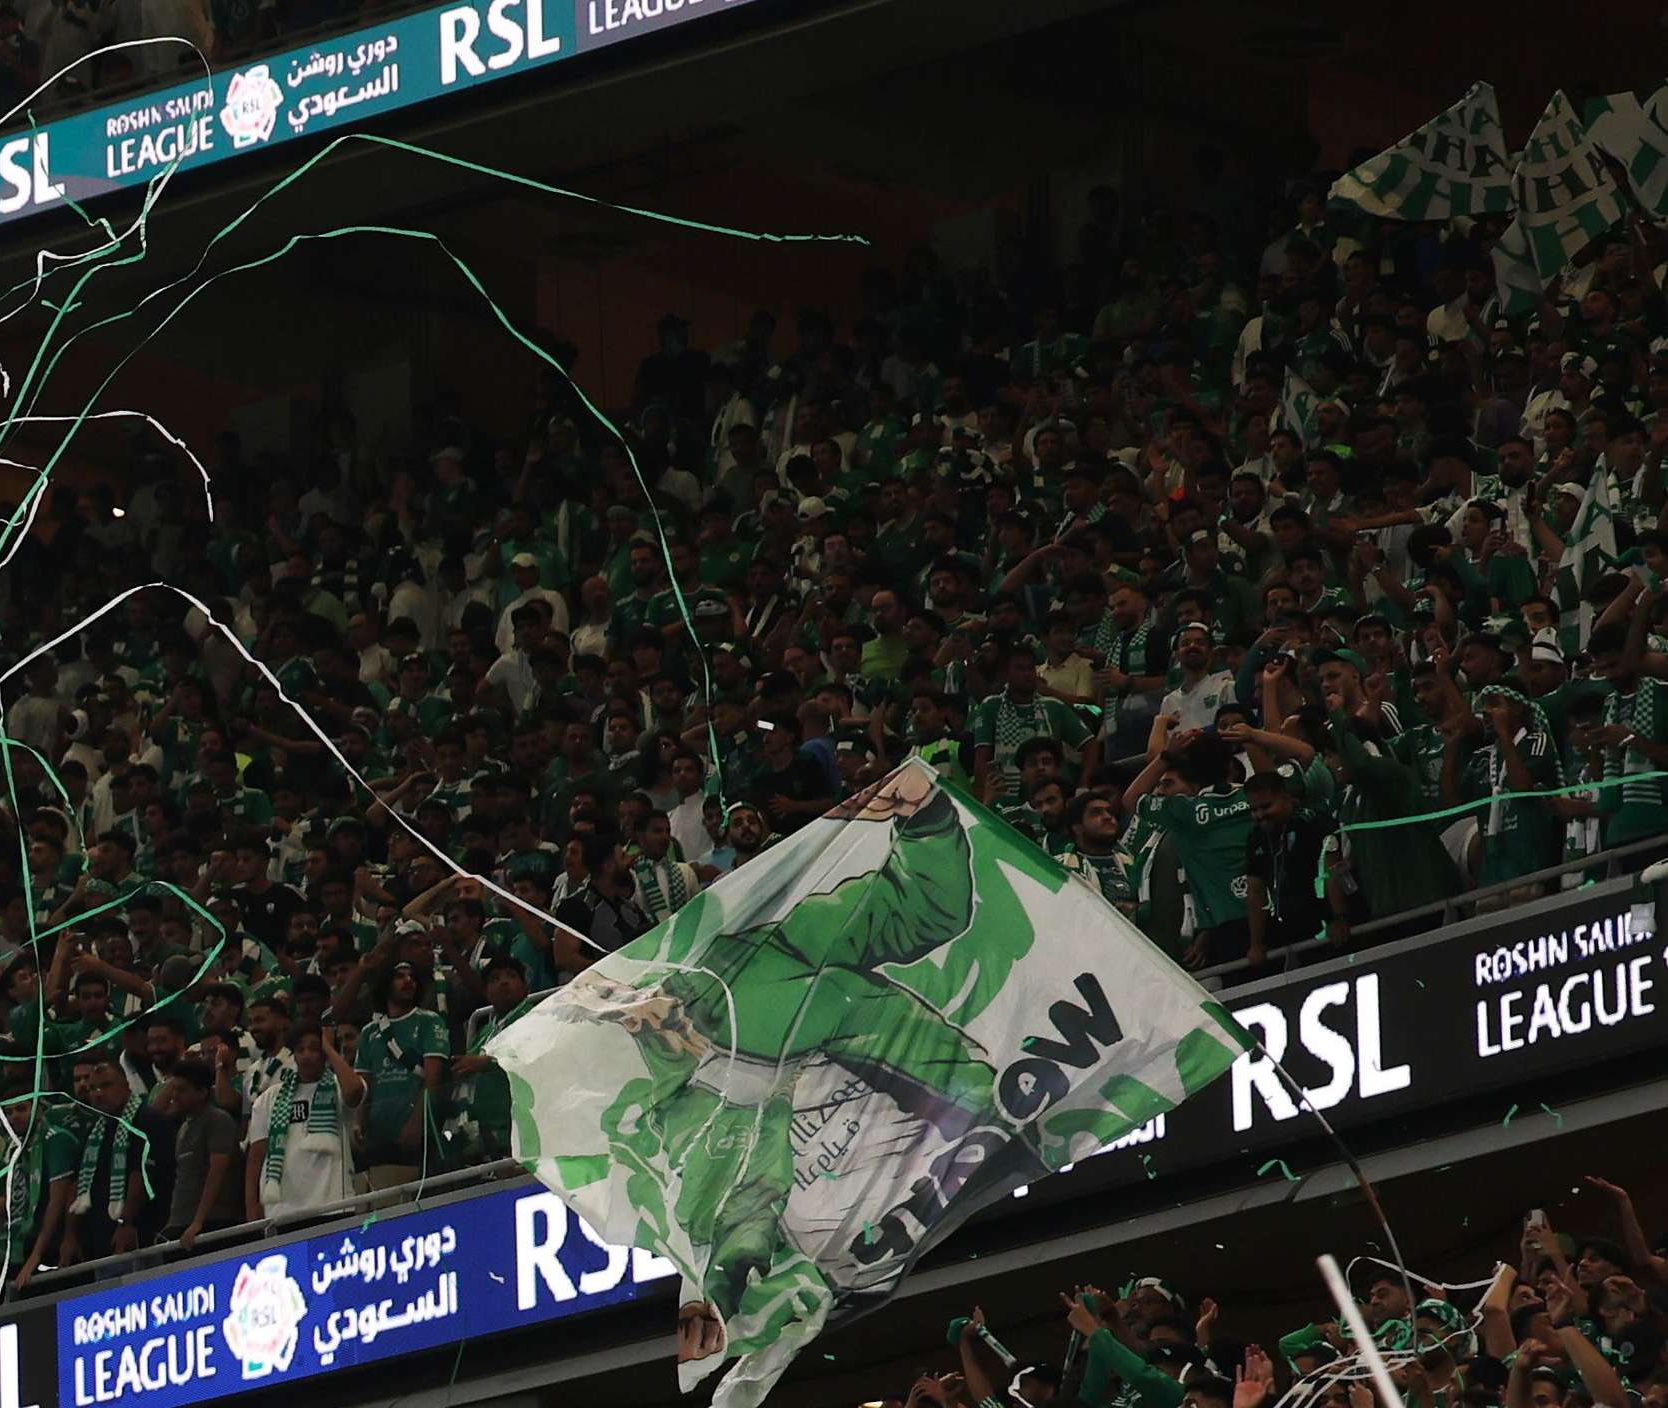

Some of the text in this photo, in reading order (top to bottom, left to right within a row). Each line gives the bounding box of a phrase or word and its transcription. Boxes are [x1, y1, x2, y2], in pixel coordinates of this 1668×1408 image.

[439, 0, 561, 86] RSL
[588, 0, 709, 35] LEAG
[287, 31, 400, 88] دوري روشن
[106, 88, 215, 139] ROSHN SAUDI
[287, 62, 400, 133] السعودي
[106, 115, 215, 179] LEAGUE
[1213, 800, 1251, 818] urpa
[1475, 910, 1654, 987] ROSHN SAU
[1476, 954, 1655, 1058] LEAGUE
[1230, 972, 1411, 1132] RSL
[311, 1223, 457, 1295] دوري روشن
[73, 1282, 216, 1346] ROSHN SAUDI
[312, 1269, 459, 1366] السعودي
[74, 1324, 217, 1407] LEAGUE
